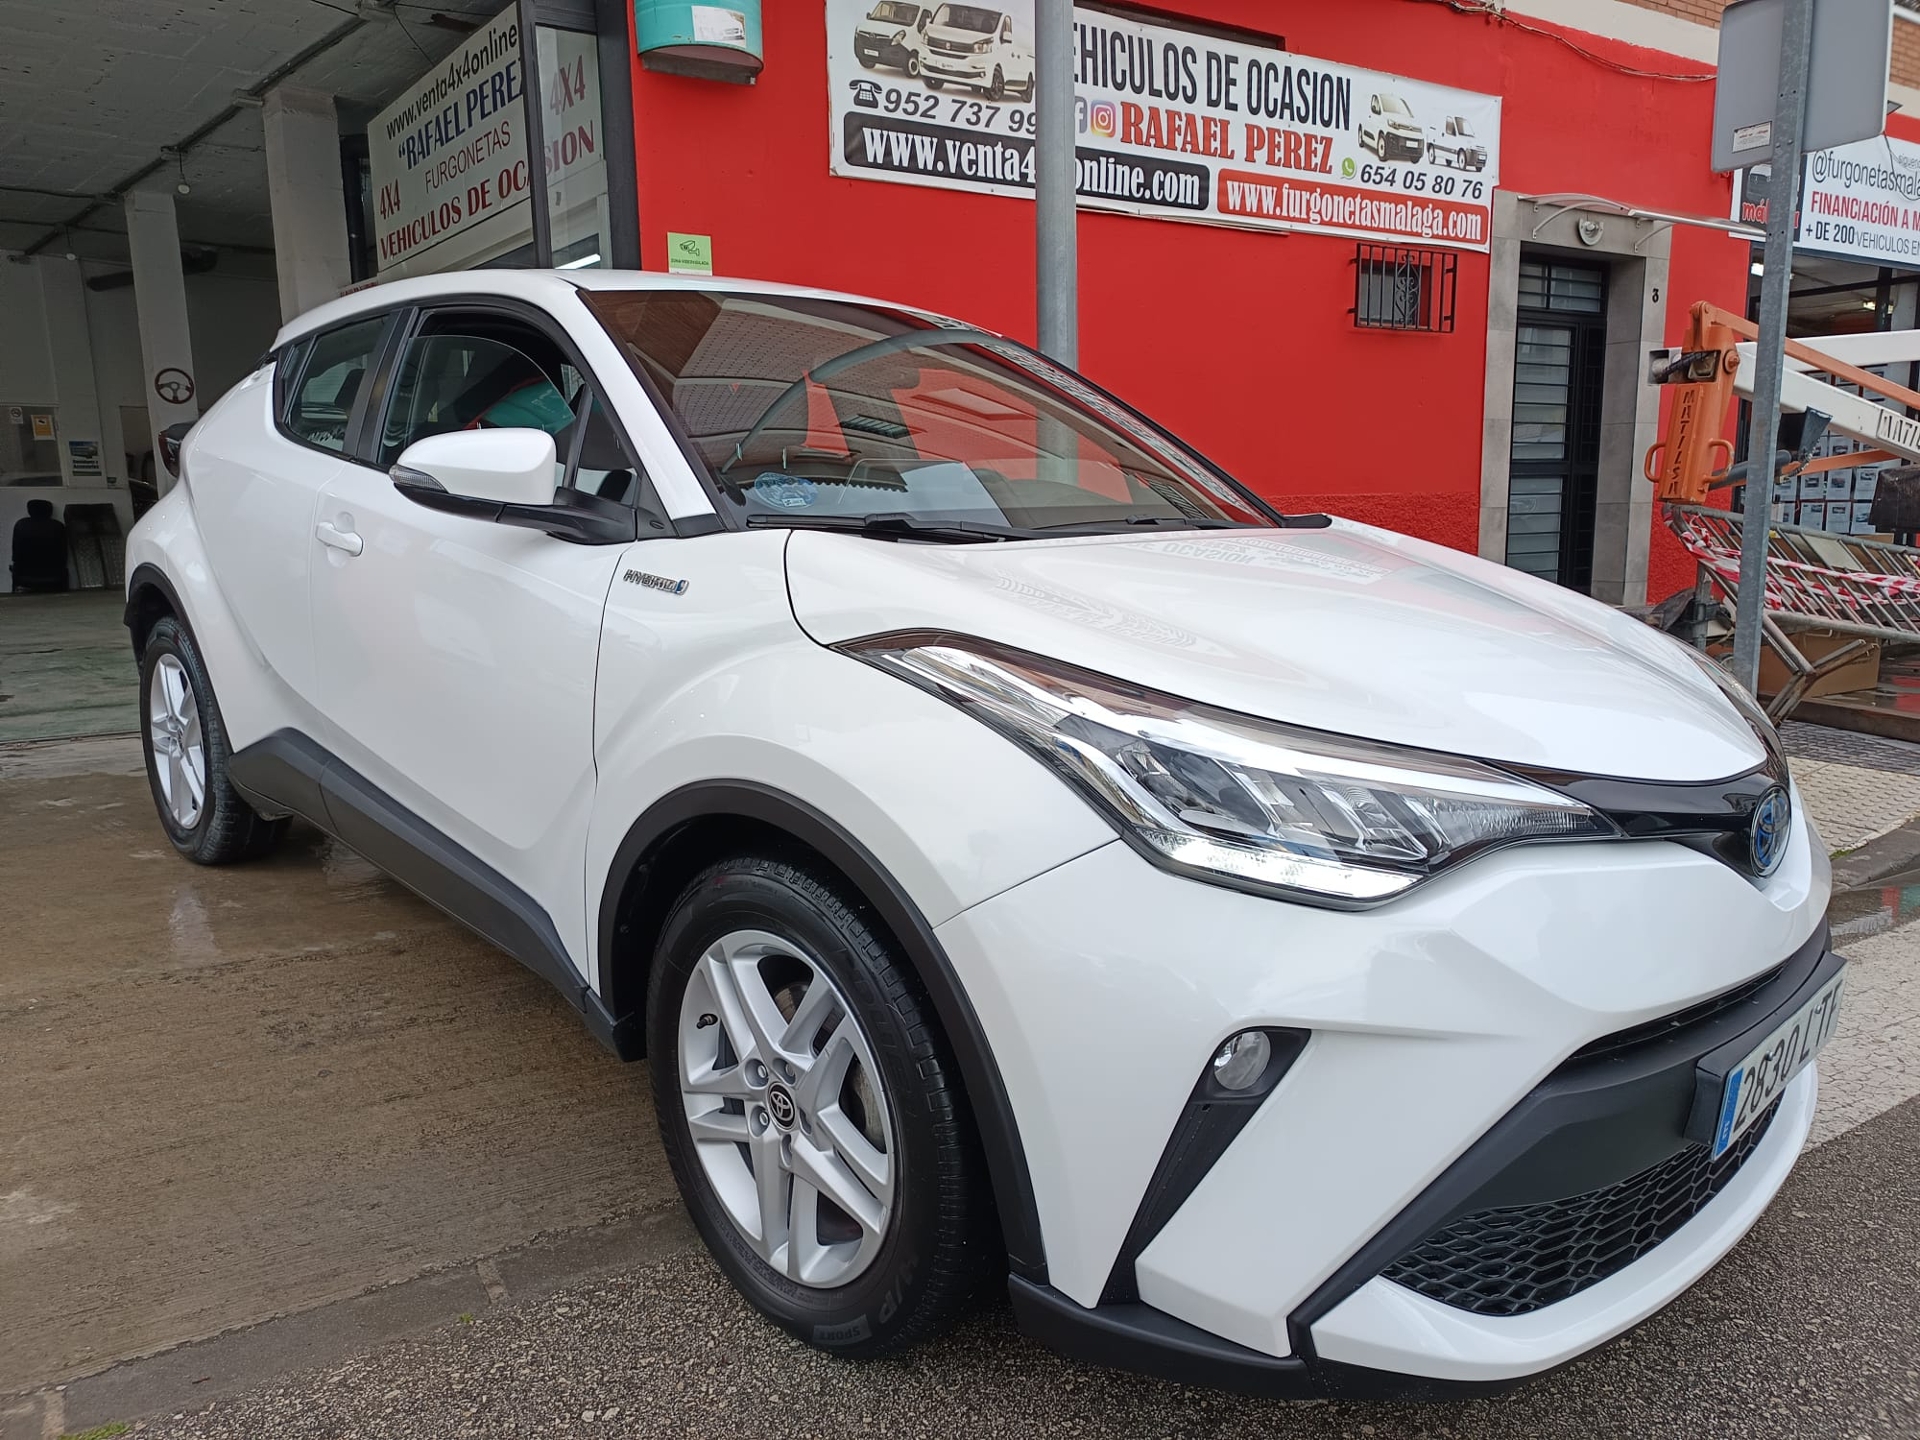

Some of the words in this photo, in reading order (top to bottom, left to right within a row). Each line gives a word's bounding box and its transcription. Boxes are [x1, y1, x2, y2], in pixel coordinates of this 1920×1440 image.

[466, 58, 523, 128] PERE
[883, 88, 940, 119] 952
[949, 99, 1001, 128] 737
[1074, 22, 1198, 105] HICULOS
[1206, 50, 1239, 111] DE
[1246, 58, 1351, 131] OCASION
[380, 179, 401, 220] 4X4
[425, 120, 511, 193] FURGONETAS
[550, 55, 585, 116] 4X4
[1120, 101, 1235, 161] RAFAEL
[1244, 123, 1334, 175] PEREZ
[1226, 177, 1482, 240] www.furgonetasmalaga.com
[1361, 163, 1397, 187] 654
[1403, 169, 1426, 192] 05
[1432, 172, 1455, 196] 80
[1461, 178, 1483, 200] 76
[1811, 191, 1899, 228] FINANCIACIÓN
[1901, 208, 1909, 230] A
[380, 196, 461, 261] VEHICULOS
[467, 178, 491, 217] DE
[1815, 221, 1829, 241] DE
[1834, 224, 1855, 244] 200
[1855, 231, 1909, 255] VEHICULOS
[1668, 390, 1695, 495] MATILSA
[1733, 1024, 1800, 1133] 2830
